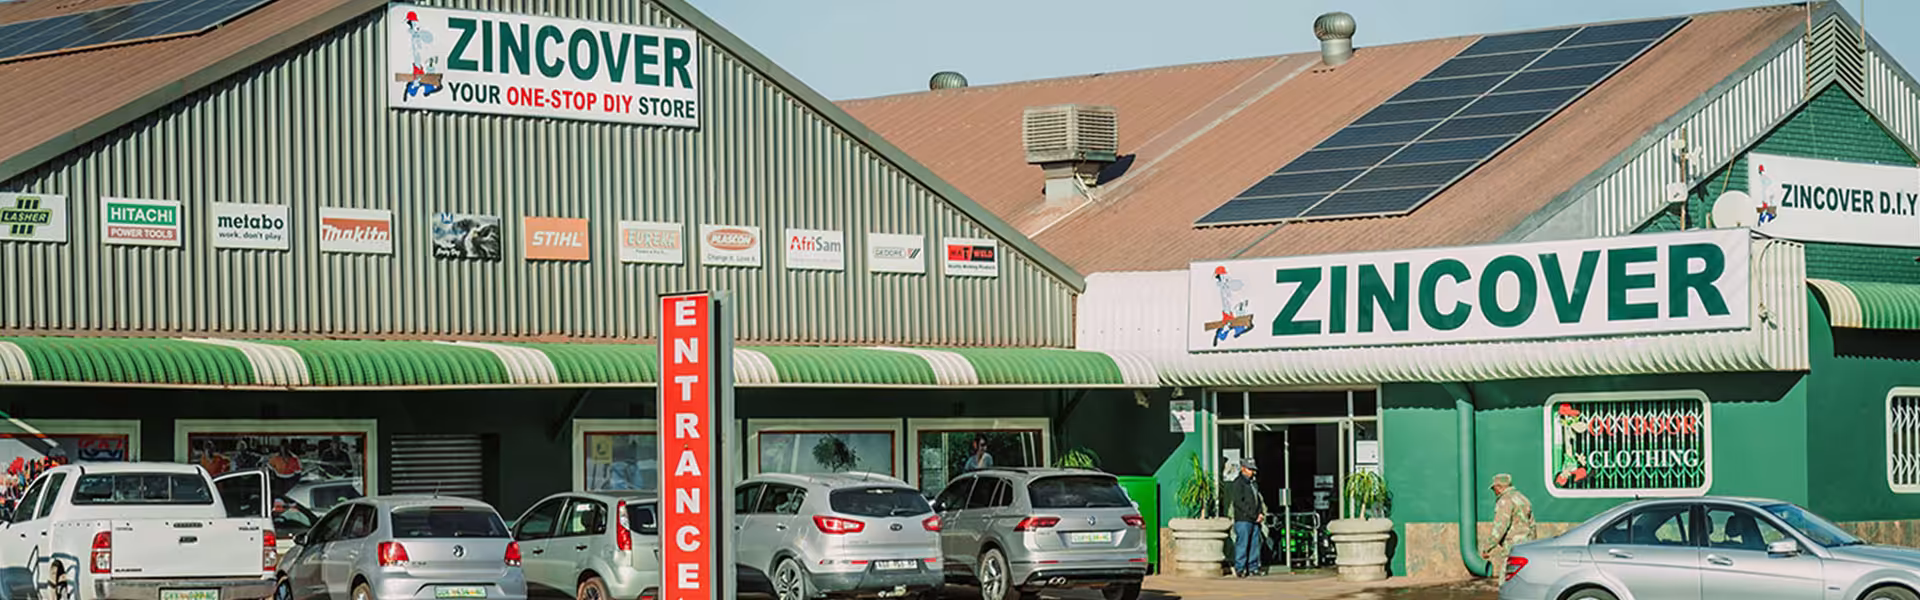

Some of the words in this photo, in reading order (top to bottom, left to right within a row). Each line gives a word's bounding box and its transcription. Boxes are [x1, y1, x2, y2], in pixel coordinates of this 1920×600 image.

[447, 17, 694, 89] ZINCOVER
[448, 82, 501, 105] YOUR
[507, 86, 597, 111] ONE-STOP
[603, 95, 633, 114] DIY
[638, 98, 695, 119] STORE
[1781, 183, 1875, 213] ZINCOVER
[1880, 191, 1918, 216] D.I.Y
[3, 211, 47, 223] LASHER
[110, 207, 173, 223] HITACHI
[217, 214, 284, 230] metabo
[111, 228, 143, 238] POWER
[144, 229, 173, 239] TOOLS
[532, 231, 582, 247] STIHL
[628, 231, 675, 248] EUREKA
[790, 236, 841, 251] AfriSam
[1271, 242, 1730, 336] ZINCOVER
[1588, 415, 1698, 436] OUTDOOR
[673, 300, 702, 589] ENTRANCE
[1589, 450, 1698, 468] CLOTHING
